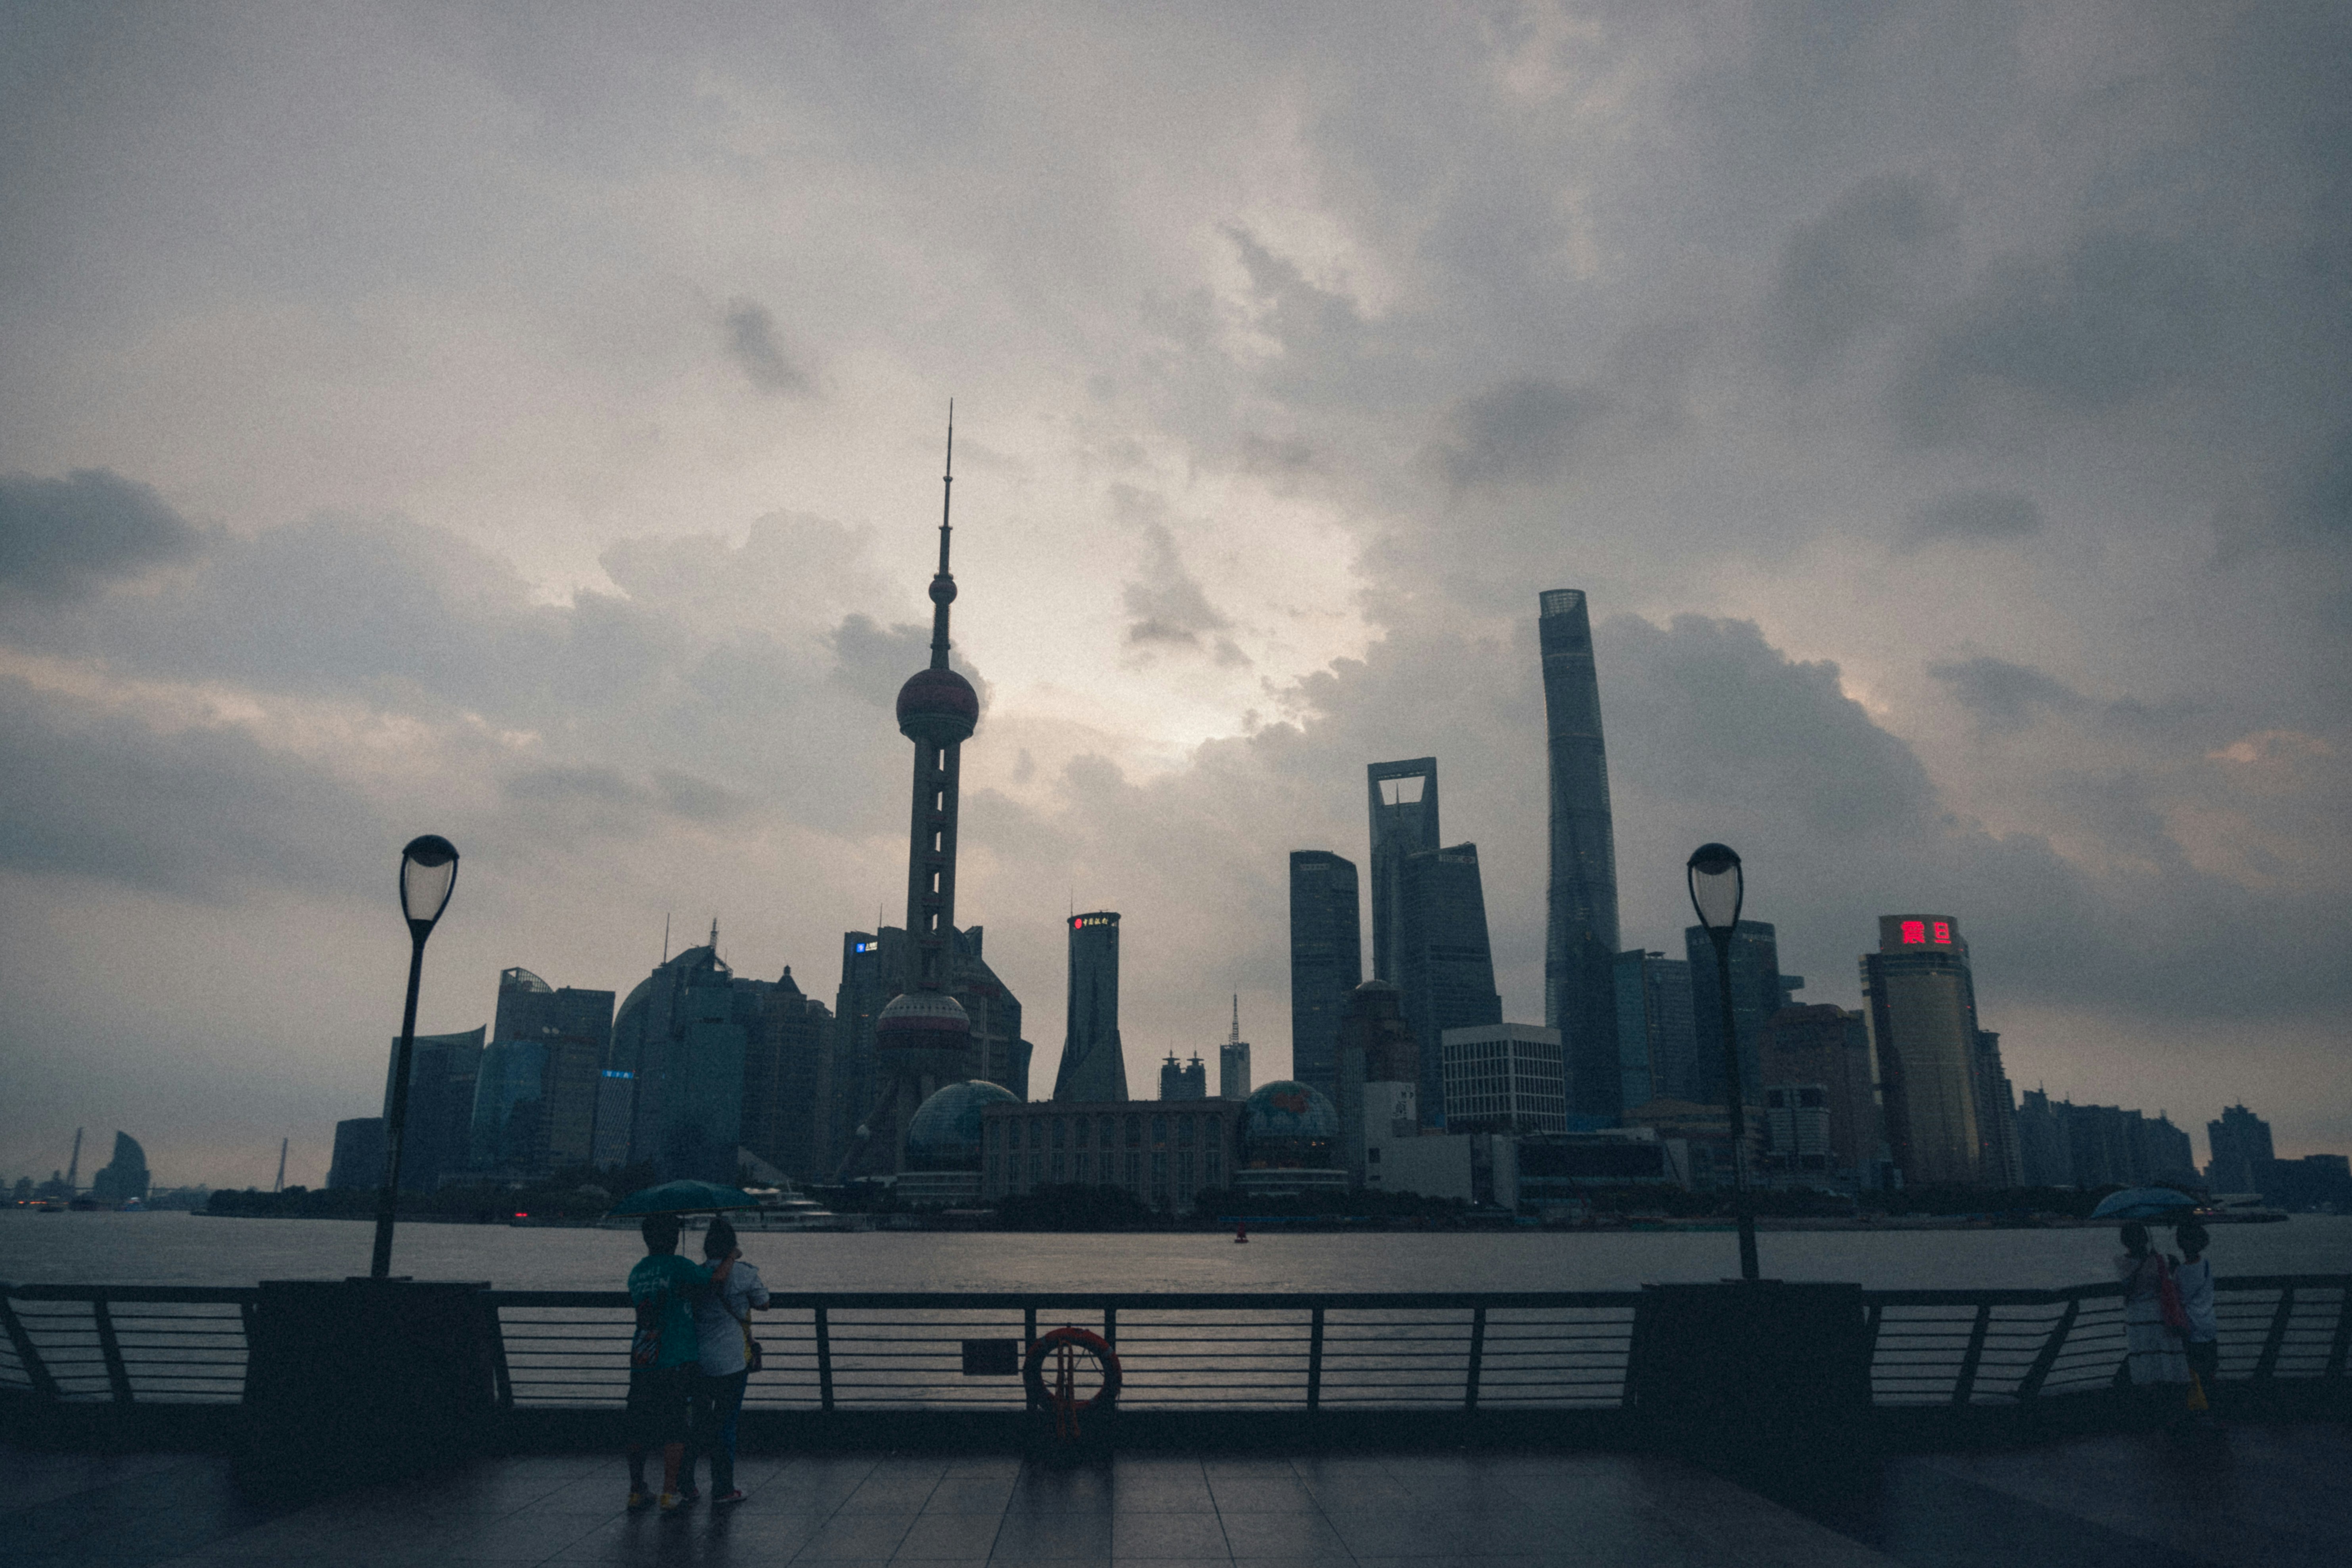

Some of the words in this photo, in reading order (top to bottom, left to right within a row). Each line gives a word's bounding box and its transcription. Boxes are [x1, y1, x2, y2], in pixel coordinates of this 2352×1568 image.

[1082, 917, 1109, 927] 中国银行
[1900, 921, 1952, 944] 震旦
